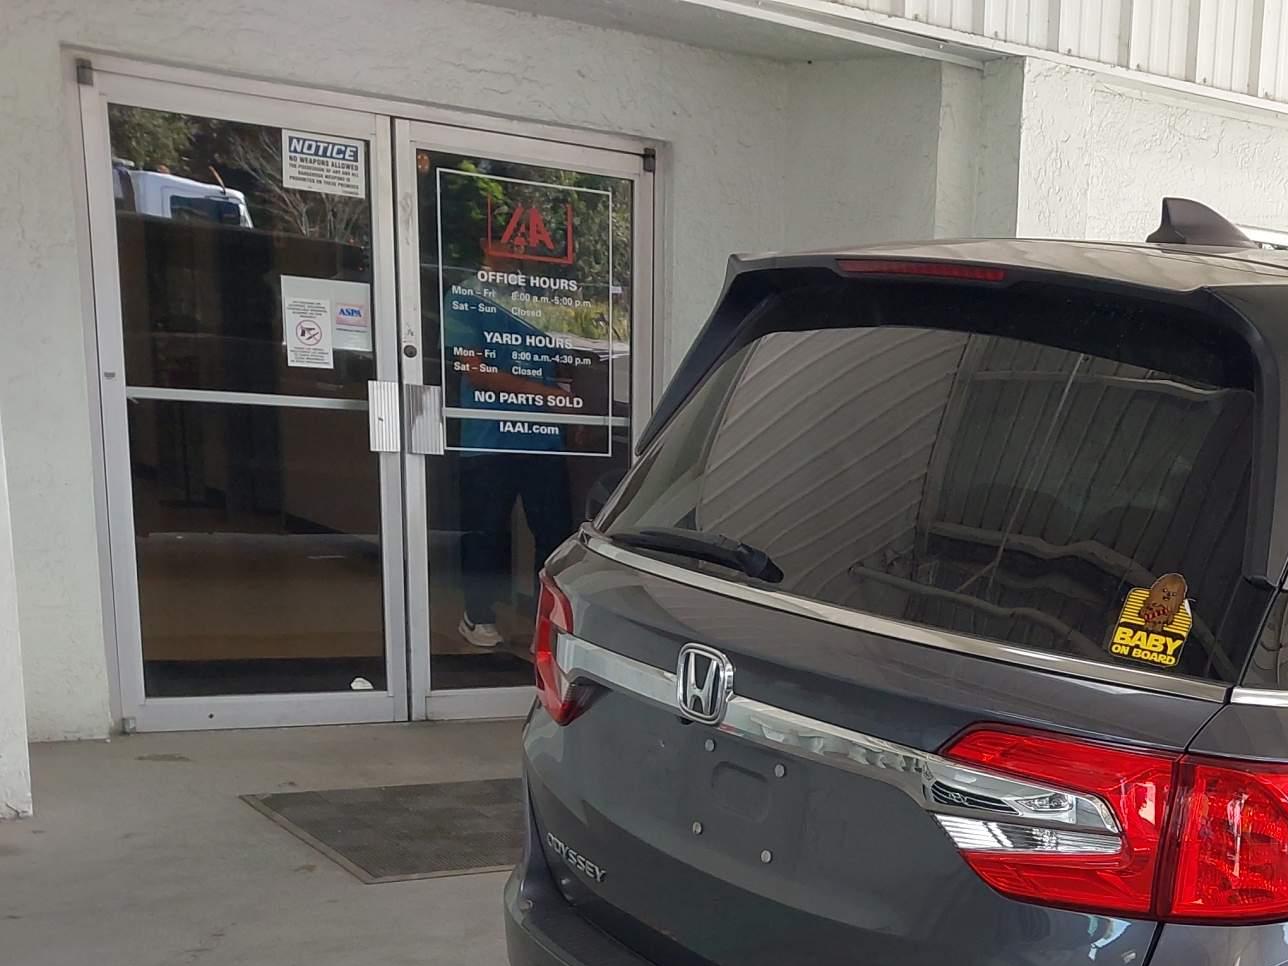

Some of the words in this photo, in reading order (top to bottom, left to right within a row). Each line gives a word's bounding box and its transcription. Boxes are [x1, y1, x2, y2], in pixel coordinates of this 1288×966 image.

[290, 138, 357, 160] NOTICE
[331, 161, 359, 171] ALLOWED
[477, 271, 526, 286] OFFICE
[530, 276, 578, 291] HOURS
[451, 285, 474, 296] Mon
[483, 288, 496, 298] Fri
[339, 307, 362, 318] ASPA
[452, 301, 469, 311] Sat
[478, 303, 497, 313] Sun
[511, 307, 542, 317] Closed
[483, 331, 522, 345] YARD
[526, 335, 573, 349] HOURS
[453, 347, 475, 357] Mon
[484, 349, 496, 359] Fri
[511, 350, 531, 361] 8:00
[453, 362, 470, 372] Sat
[479, 364, 498, 373] Sun
[511, 366, 543, 376] Closed
[474, 390, 496, 402] NO
[500, 392, 544, 406] PARTS
[547, 395, 583, 408] SOLD
[500, 422, 559, 435] IAAI.com
[1112, 626, 1184, 655] BABY
[1111, 644, 1130, 655] ON
[1131, 648, 1176, 665] BOARD
[547, 832, 606, 882] ODYSSEY
